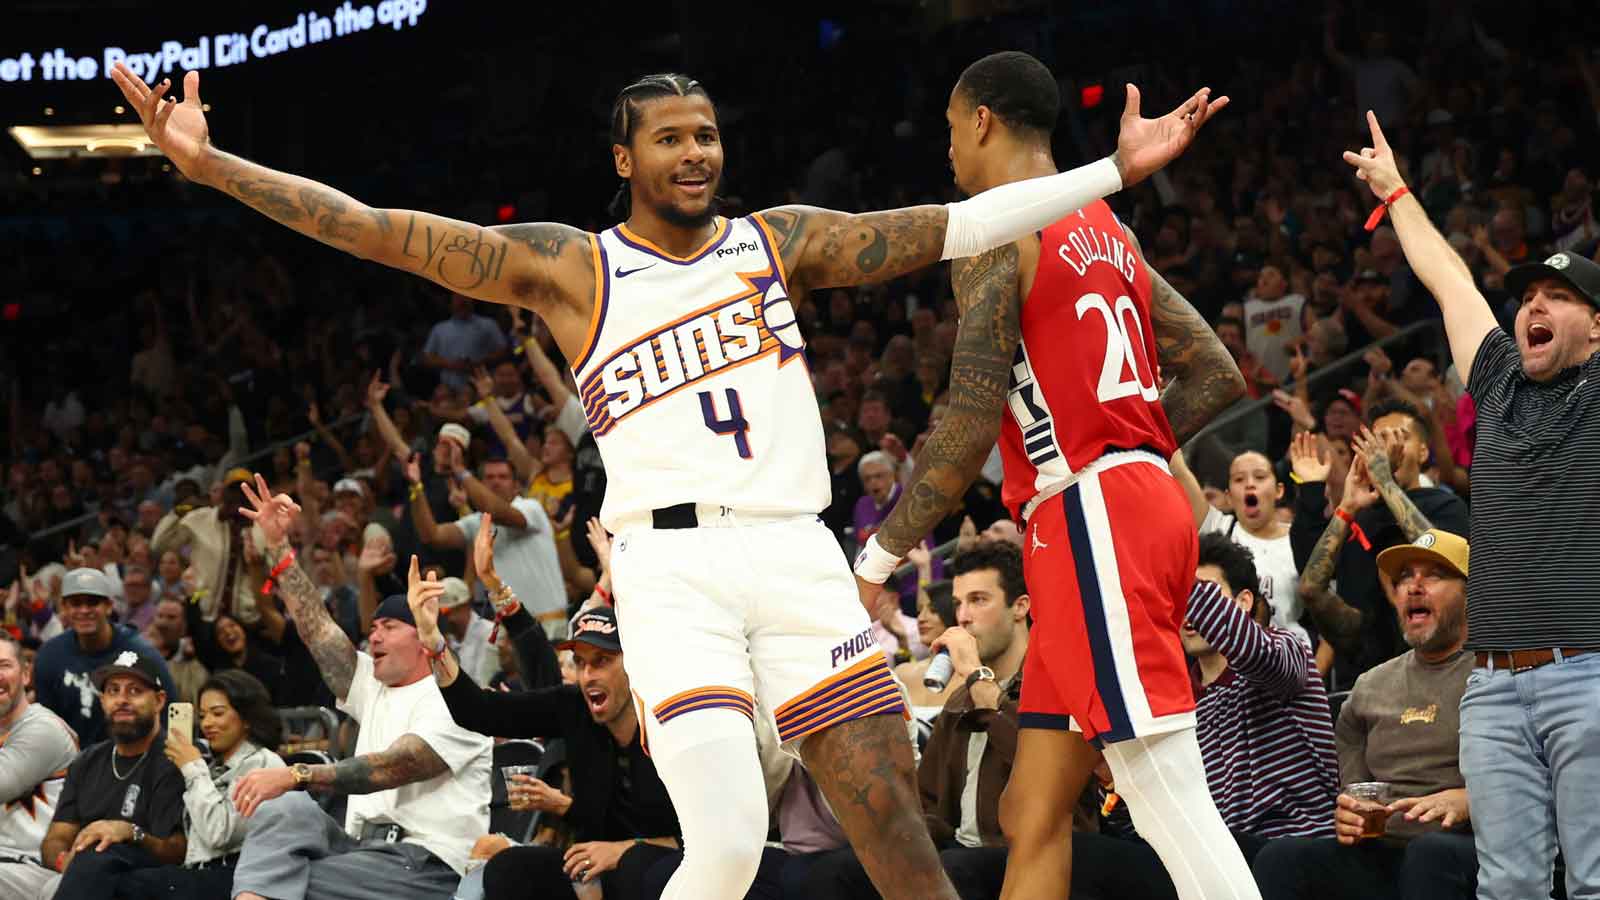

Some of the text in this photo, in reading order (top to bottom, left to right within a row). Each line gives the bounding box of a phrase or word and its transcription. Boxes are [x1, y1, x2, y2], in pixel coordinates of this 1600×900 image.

[40, 48, 98, 81] the
[103, 36, 209, 84] PayPal
[250, 13, 306, 58] Card
[308, 11, 332, 44] in
[333, 1, 375, 37] the
[377, 0, 427, 31] app
[716, 240, 759, 258] PayPal
[1058, 226, 1136, 283] COLLINS
[1074, 292, 1160, 403] 20
[696, 387, 753, 460] 4
